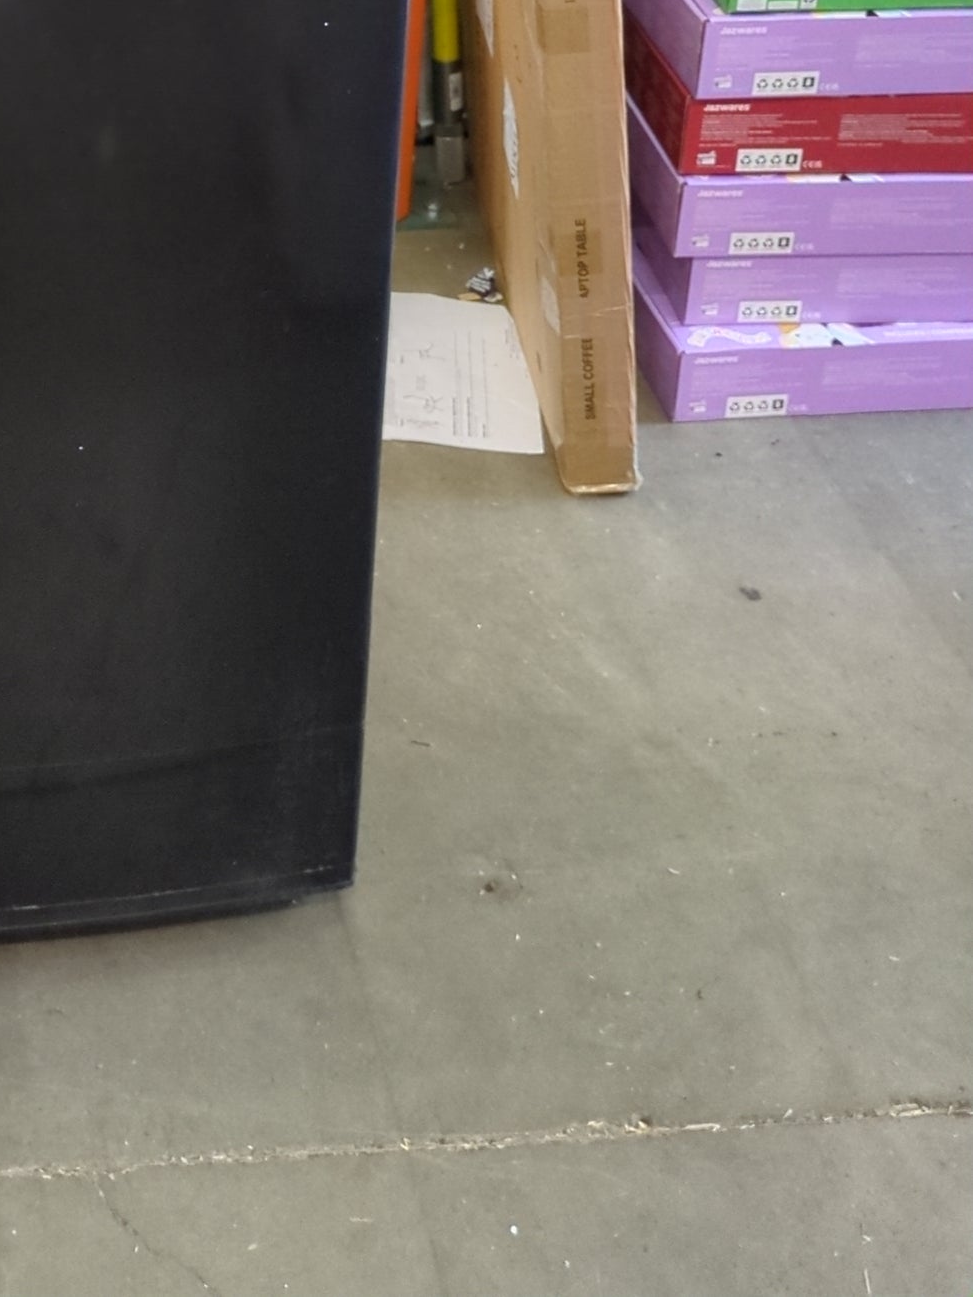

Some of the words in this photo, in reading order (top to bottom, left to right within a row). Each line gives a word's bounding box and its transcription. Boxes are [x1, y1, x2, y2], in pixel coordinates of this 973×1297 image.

[703, 103, 752, 113] Jazwares
[575, 217, 588, 259] TABLE
[584, 381, 597, 421] SMALL
